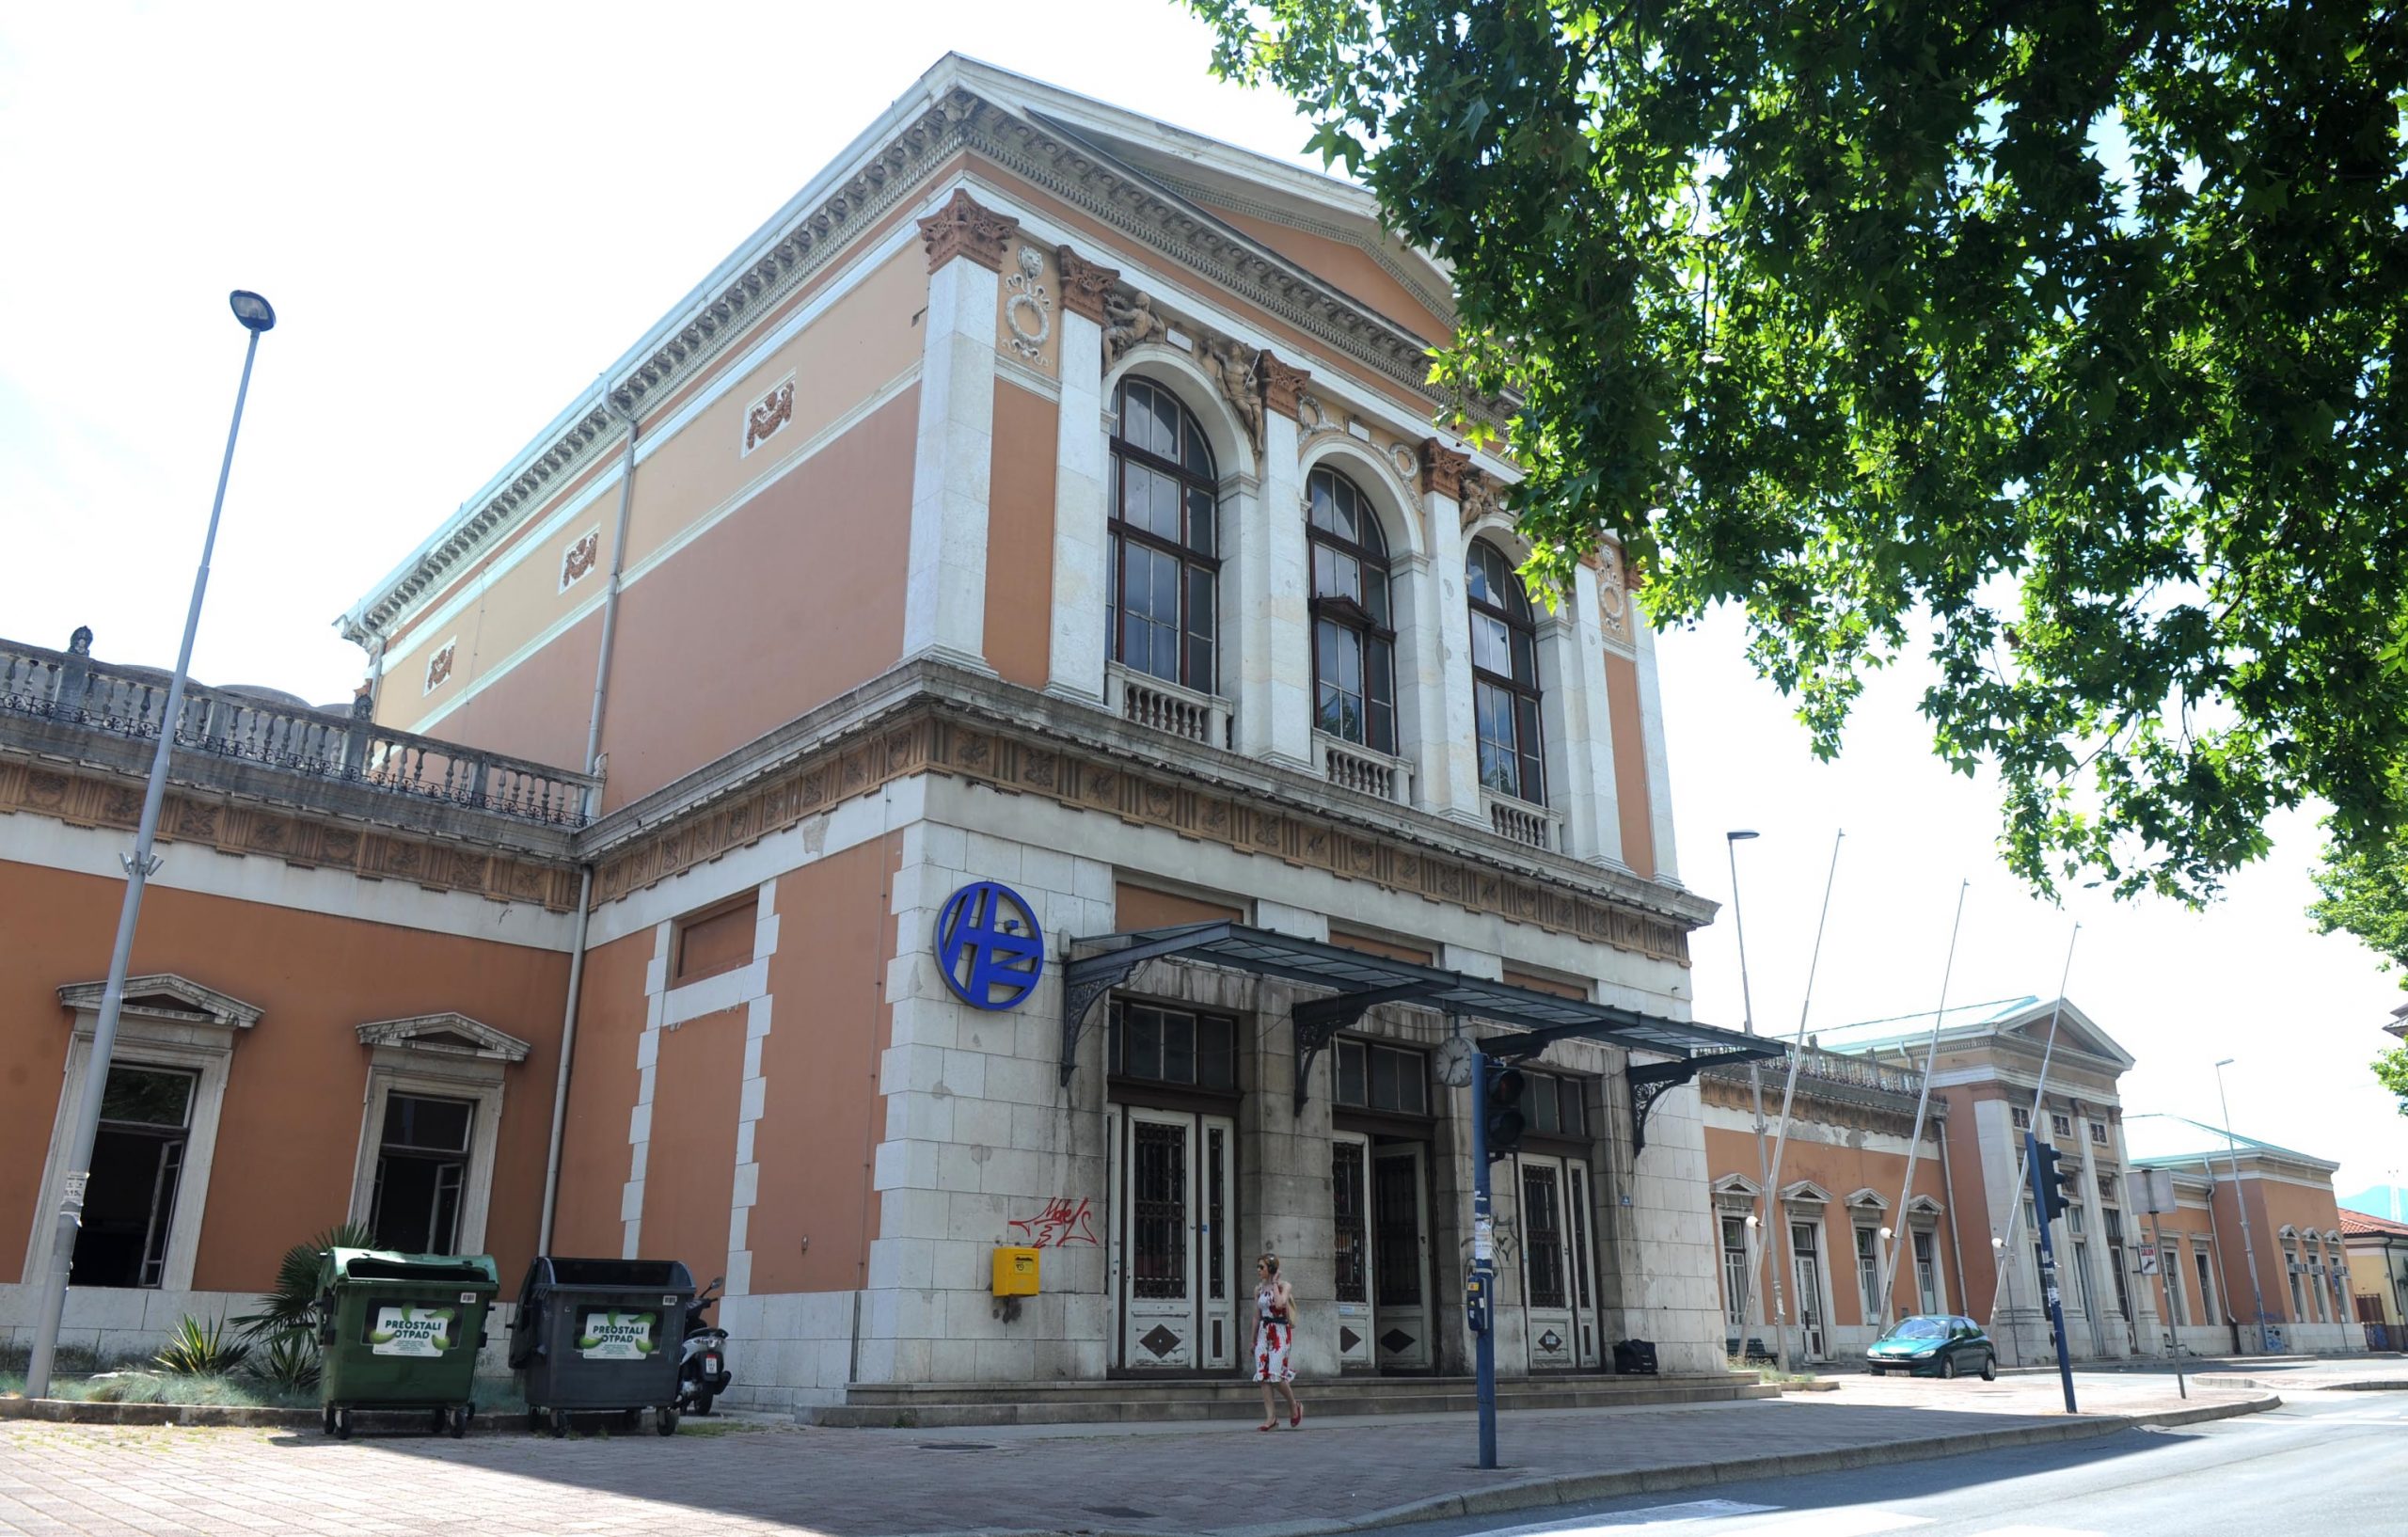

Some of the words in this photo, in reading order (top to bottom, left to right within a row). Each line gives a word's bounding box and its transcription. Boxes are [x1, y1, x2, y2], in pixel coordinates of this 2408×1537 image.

[385, 1320, 441, 1331] PREOSTALI
[593, 1324, 644, 1335] PREOSTALI
[394, 1329, 430, 1339] OTPAD
[601, 1334, 634, 1343] OTPAD
